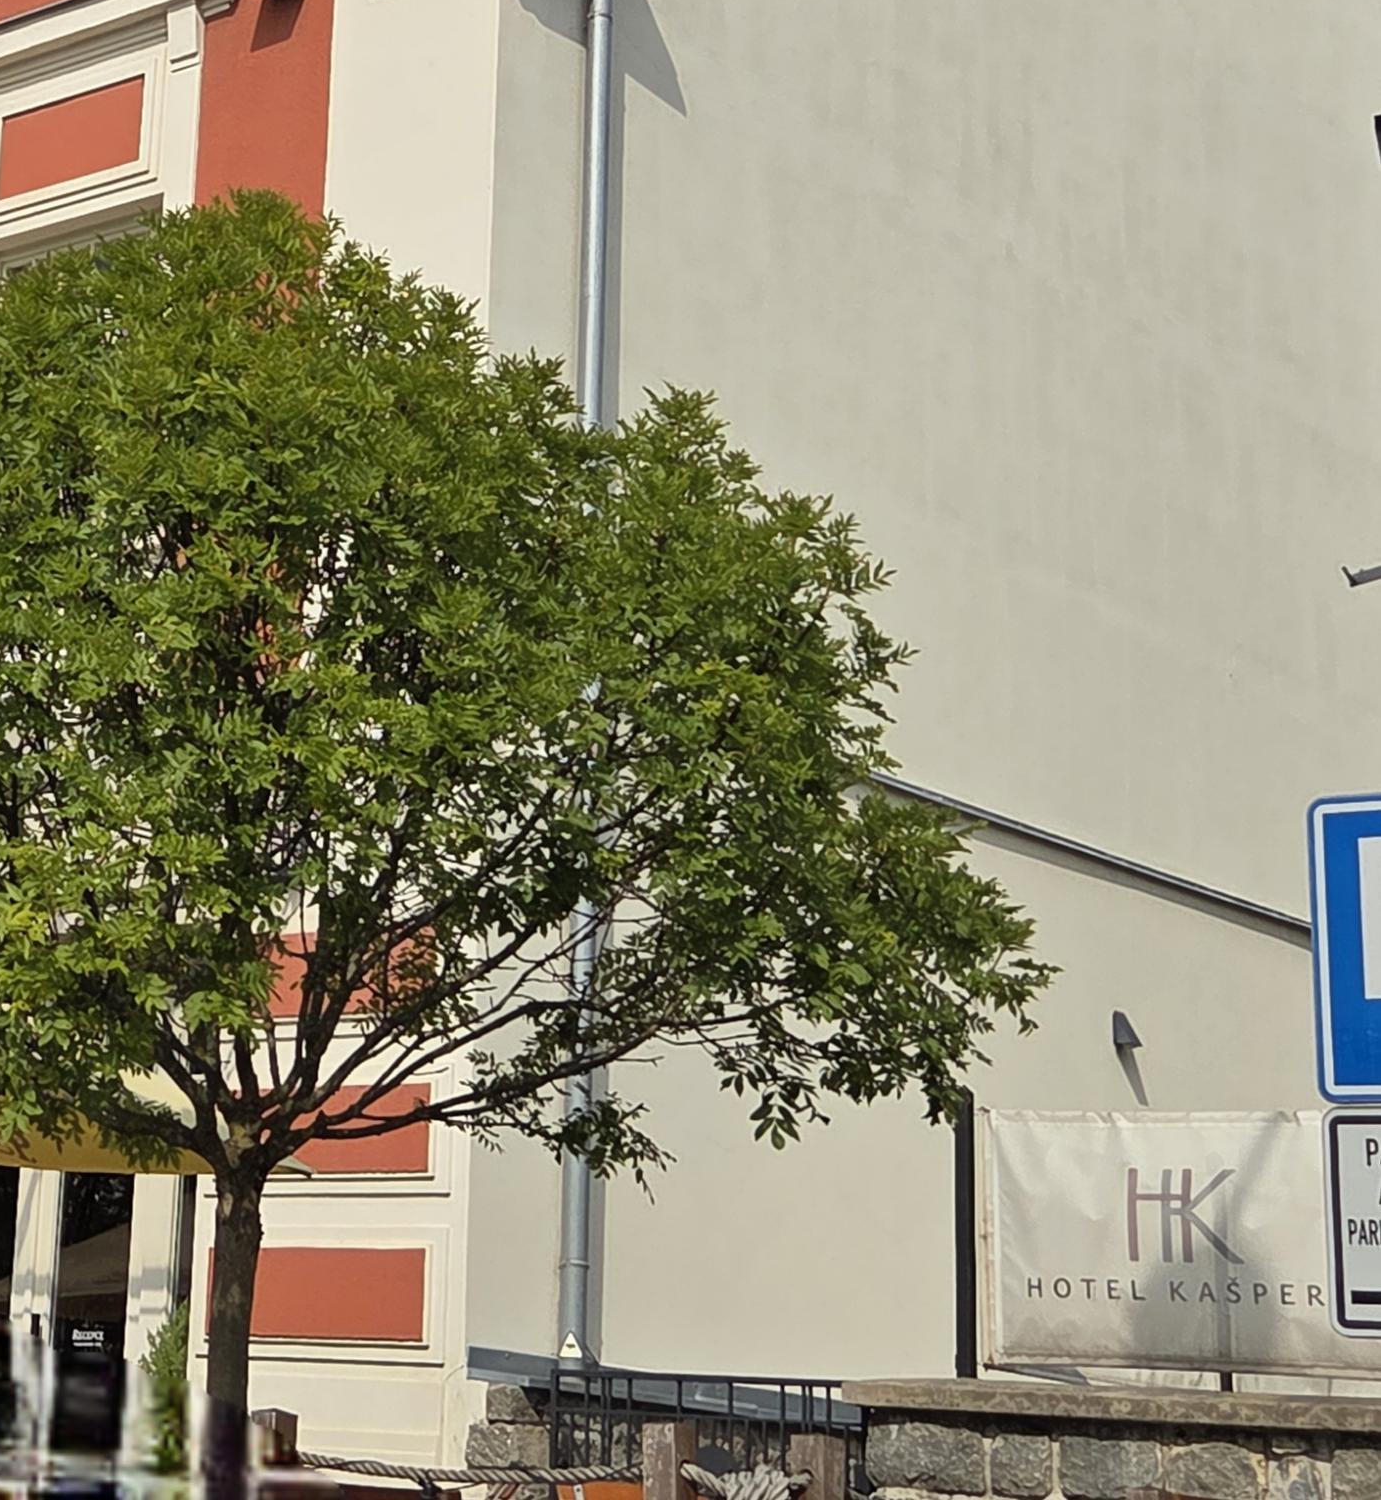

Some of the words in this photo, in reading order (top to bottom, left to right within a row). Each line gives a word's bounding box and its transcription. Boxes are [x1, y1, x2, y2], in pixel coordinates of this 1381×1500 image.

[1365, 1137, 1381, 1167] P
[1347, 1218, 1381, 1246] PAR
[1027, 1276, 1147, 1301] HOTEL
